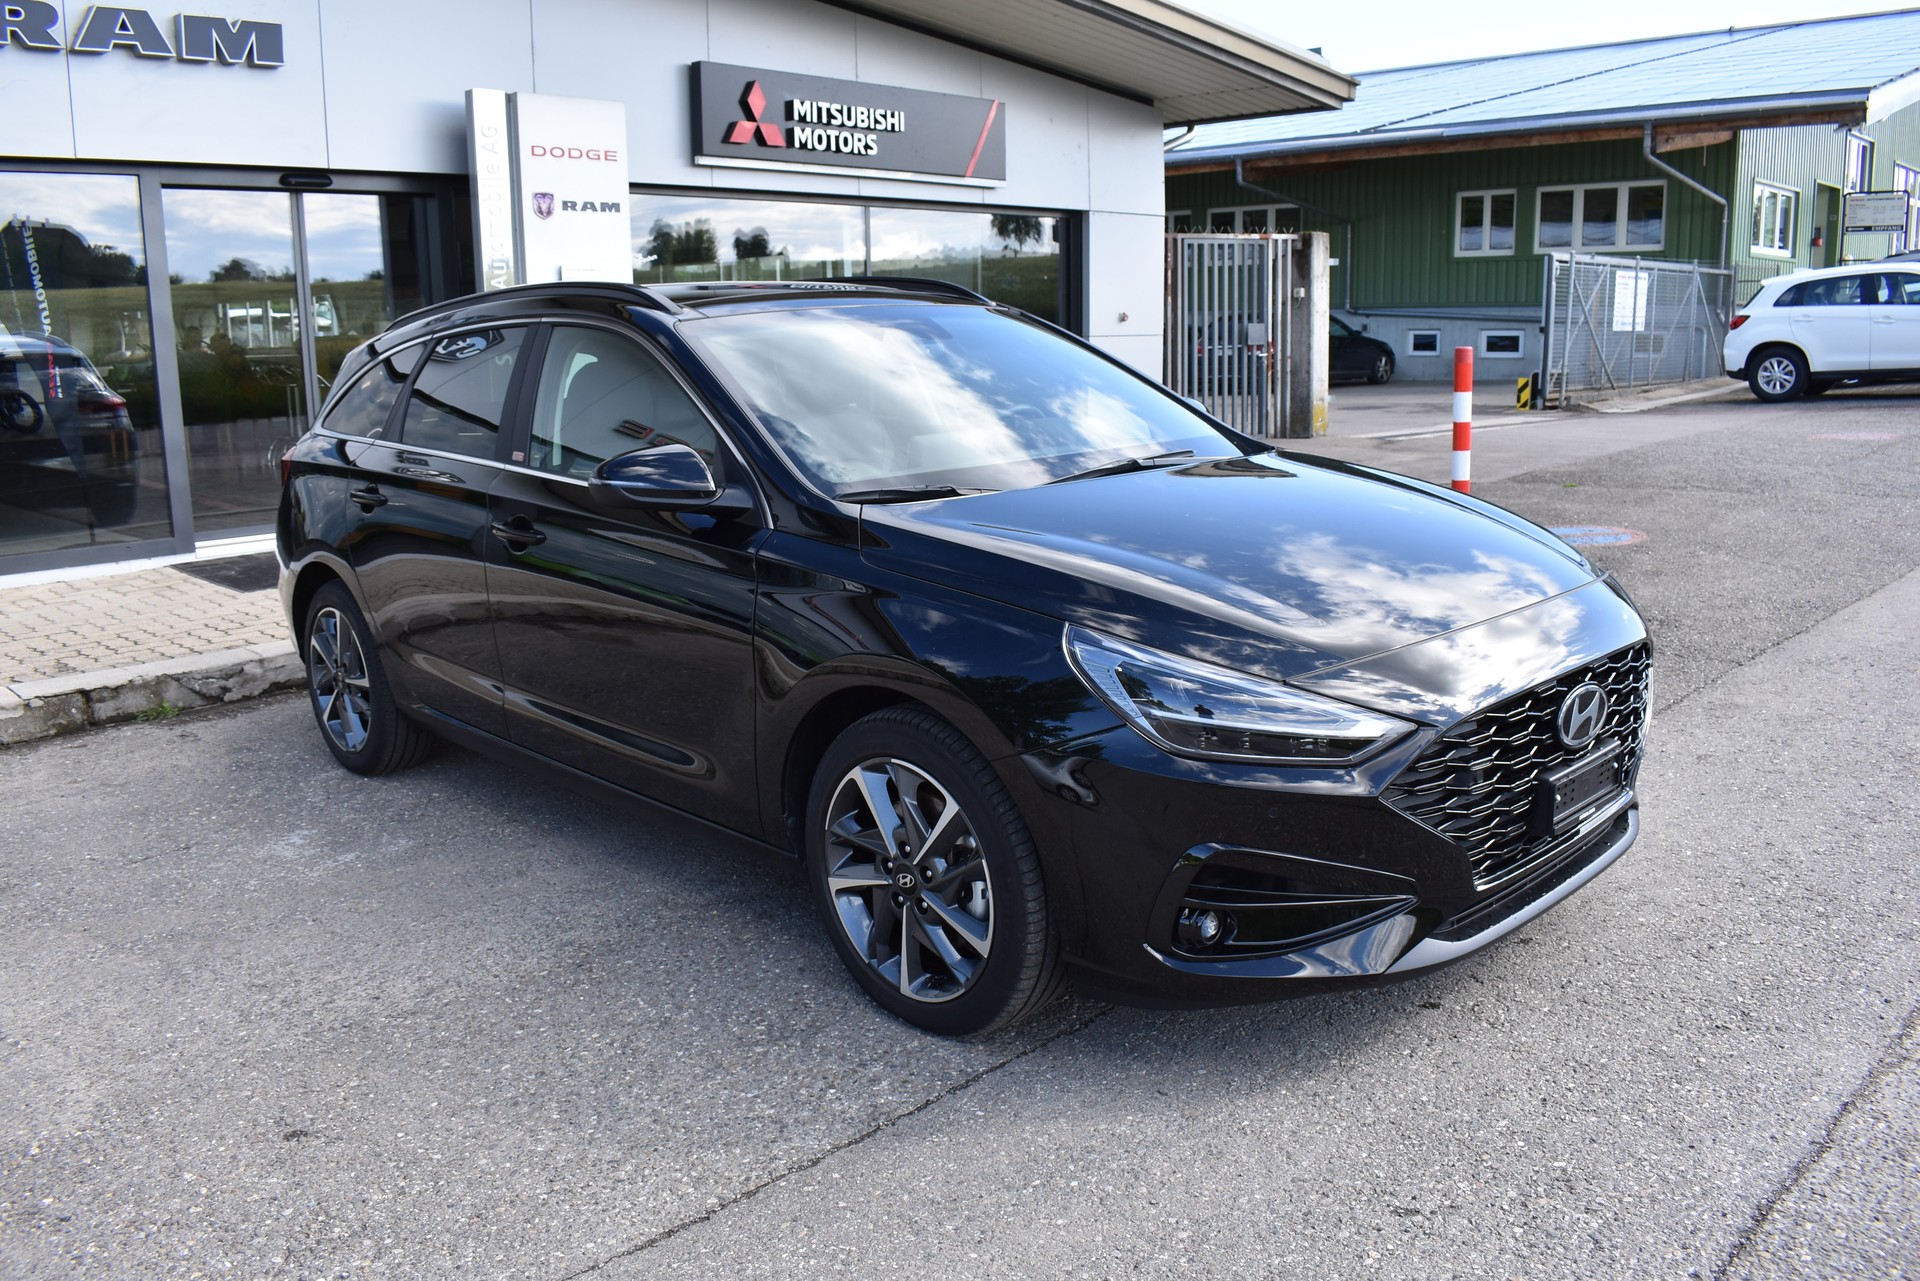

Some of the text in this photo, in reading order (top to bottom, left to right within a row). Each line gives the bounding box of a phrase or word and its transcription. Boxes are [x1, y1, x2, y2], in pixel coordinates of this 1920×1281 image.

[0, 0, 285, 67] RAM
[793, 98, 905, 132] MITSUBISHI
[481, 125, 499, 155] AG
[531, 145, 618, 161] DODGE
[793, 126, 878, 156] MOTORS
[562, 200, 621, 213] RAM
